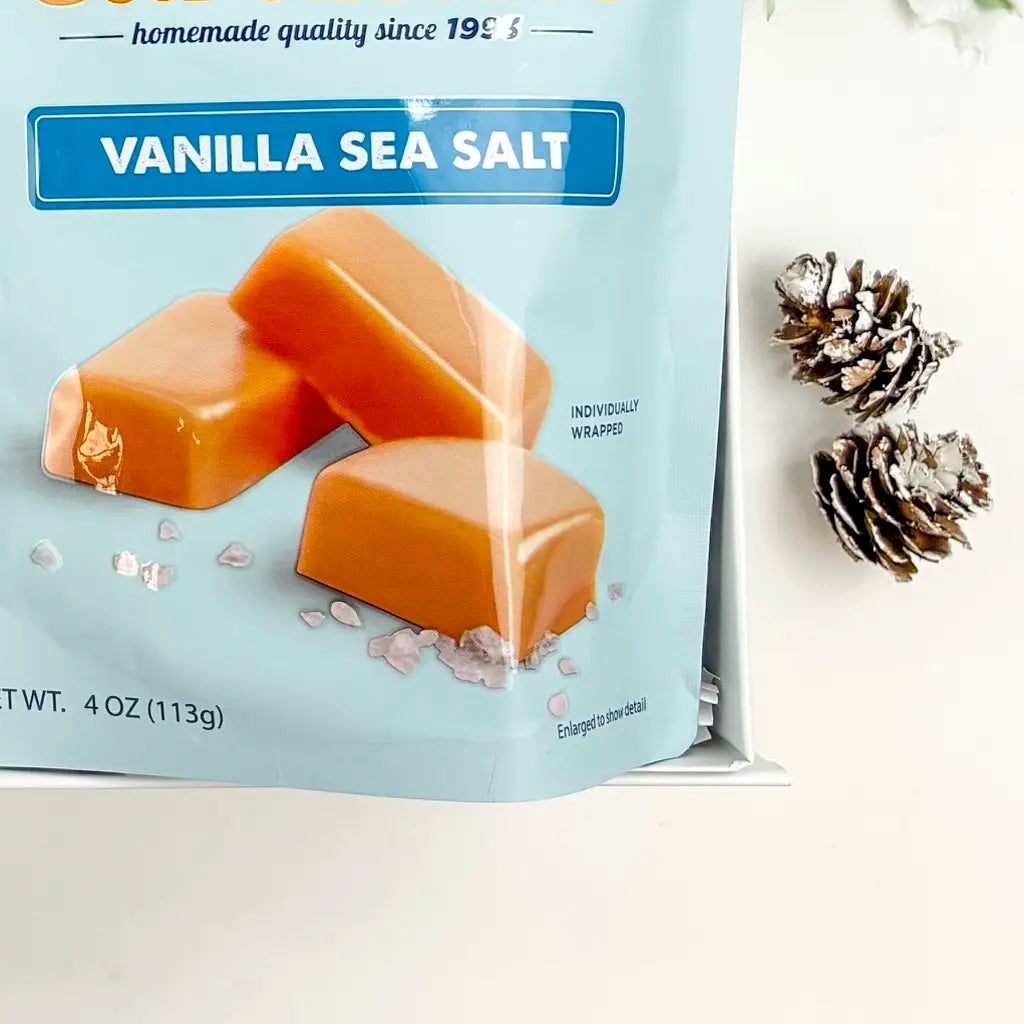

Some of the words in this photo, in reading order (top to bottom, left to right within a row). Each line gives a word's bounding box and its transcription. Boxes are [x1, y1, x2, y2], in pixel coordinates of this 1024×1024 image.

[131, 19, 270, 45] homemade
[277, 18, 368, 49] quality
[375, 17, 437, 40] since
[100, 133, 324, 174] VANILLA
[339, 131, 438, 171] SEA
[452, 130, 569, 170] SALT
[571, 398, 640, 419] INDIVIDUALLY
[570, 422, 624, 440] WRAPPED
[22, 689, 66, 713] WT.
[84, 694, 99, 715] 4
[104, 695, 141, 719] OZ
[147, 698, 224, 731] (113g)
[557, 714, 596, 739] Enlarged
[596, 713, 606, 728] to
[606, 707, 624, 724] show
[624, 696, 647, 717] detail
